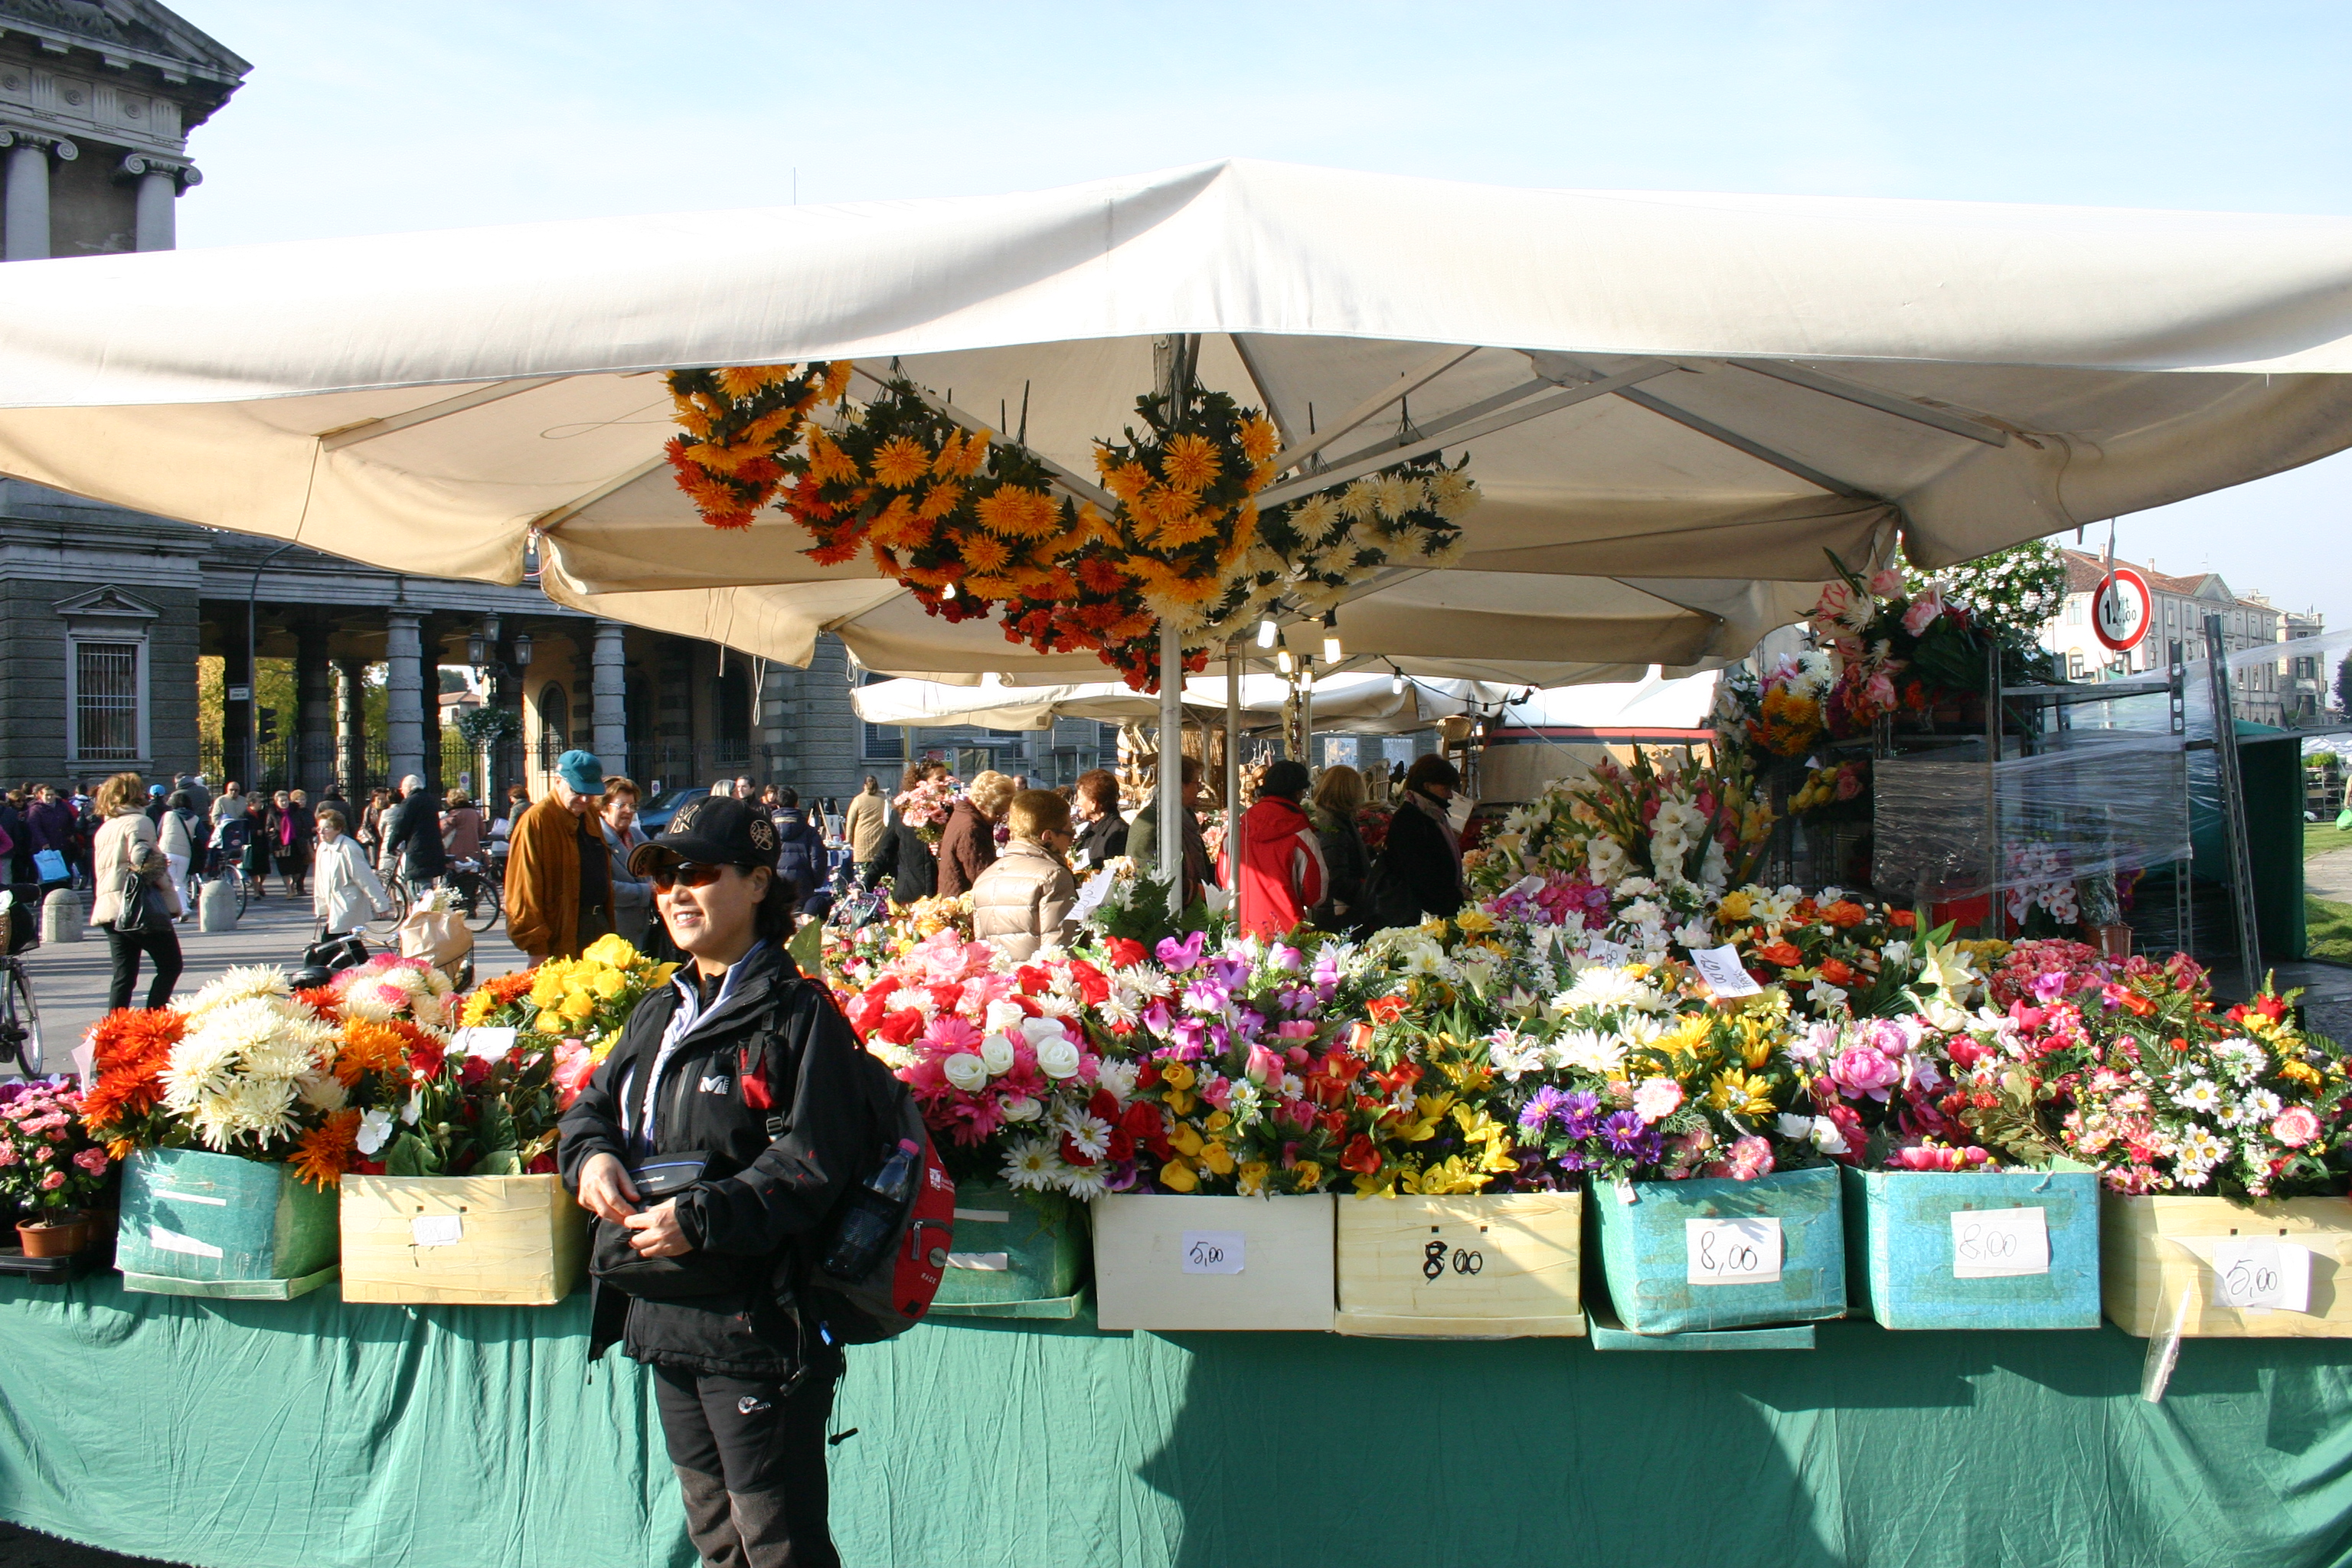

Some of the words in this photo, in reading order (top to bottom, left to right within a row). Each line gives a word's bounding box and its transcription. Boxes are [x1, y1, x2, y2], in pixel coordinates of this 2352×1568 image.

[1189, 1240, 1224, 1268] 5,00
[1700, 1230, 1758, 1277] 8,00
[2226, 1259, 2278, 1298] 5,00
